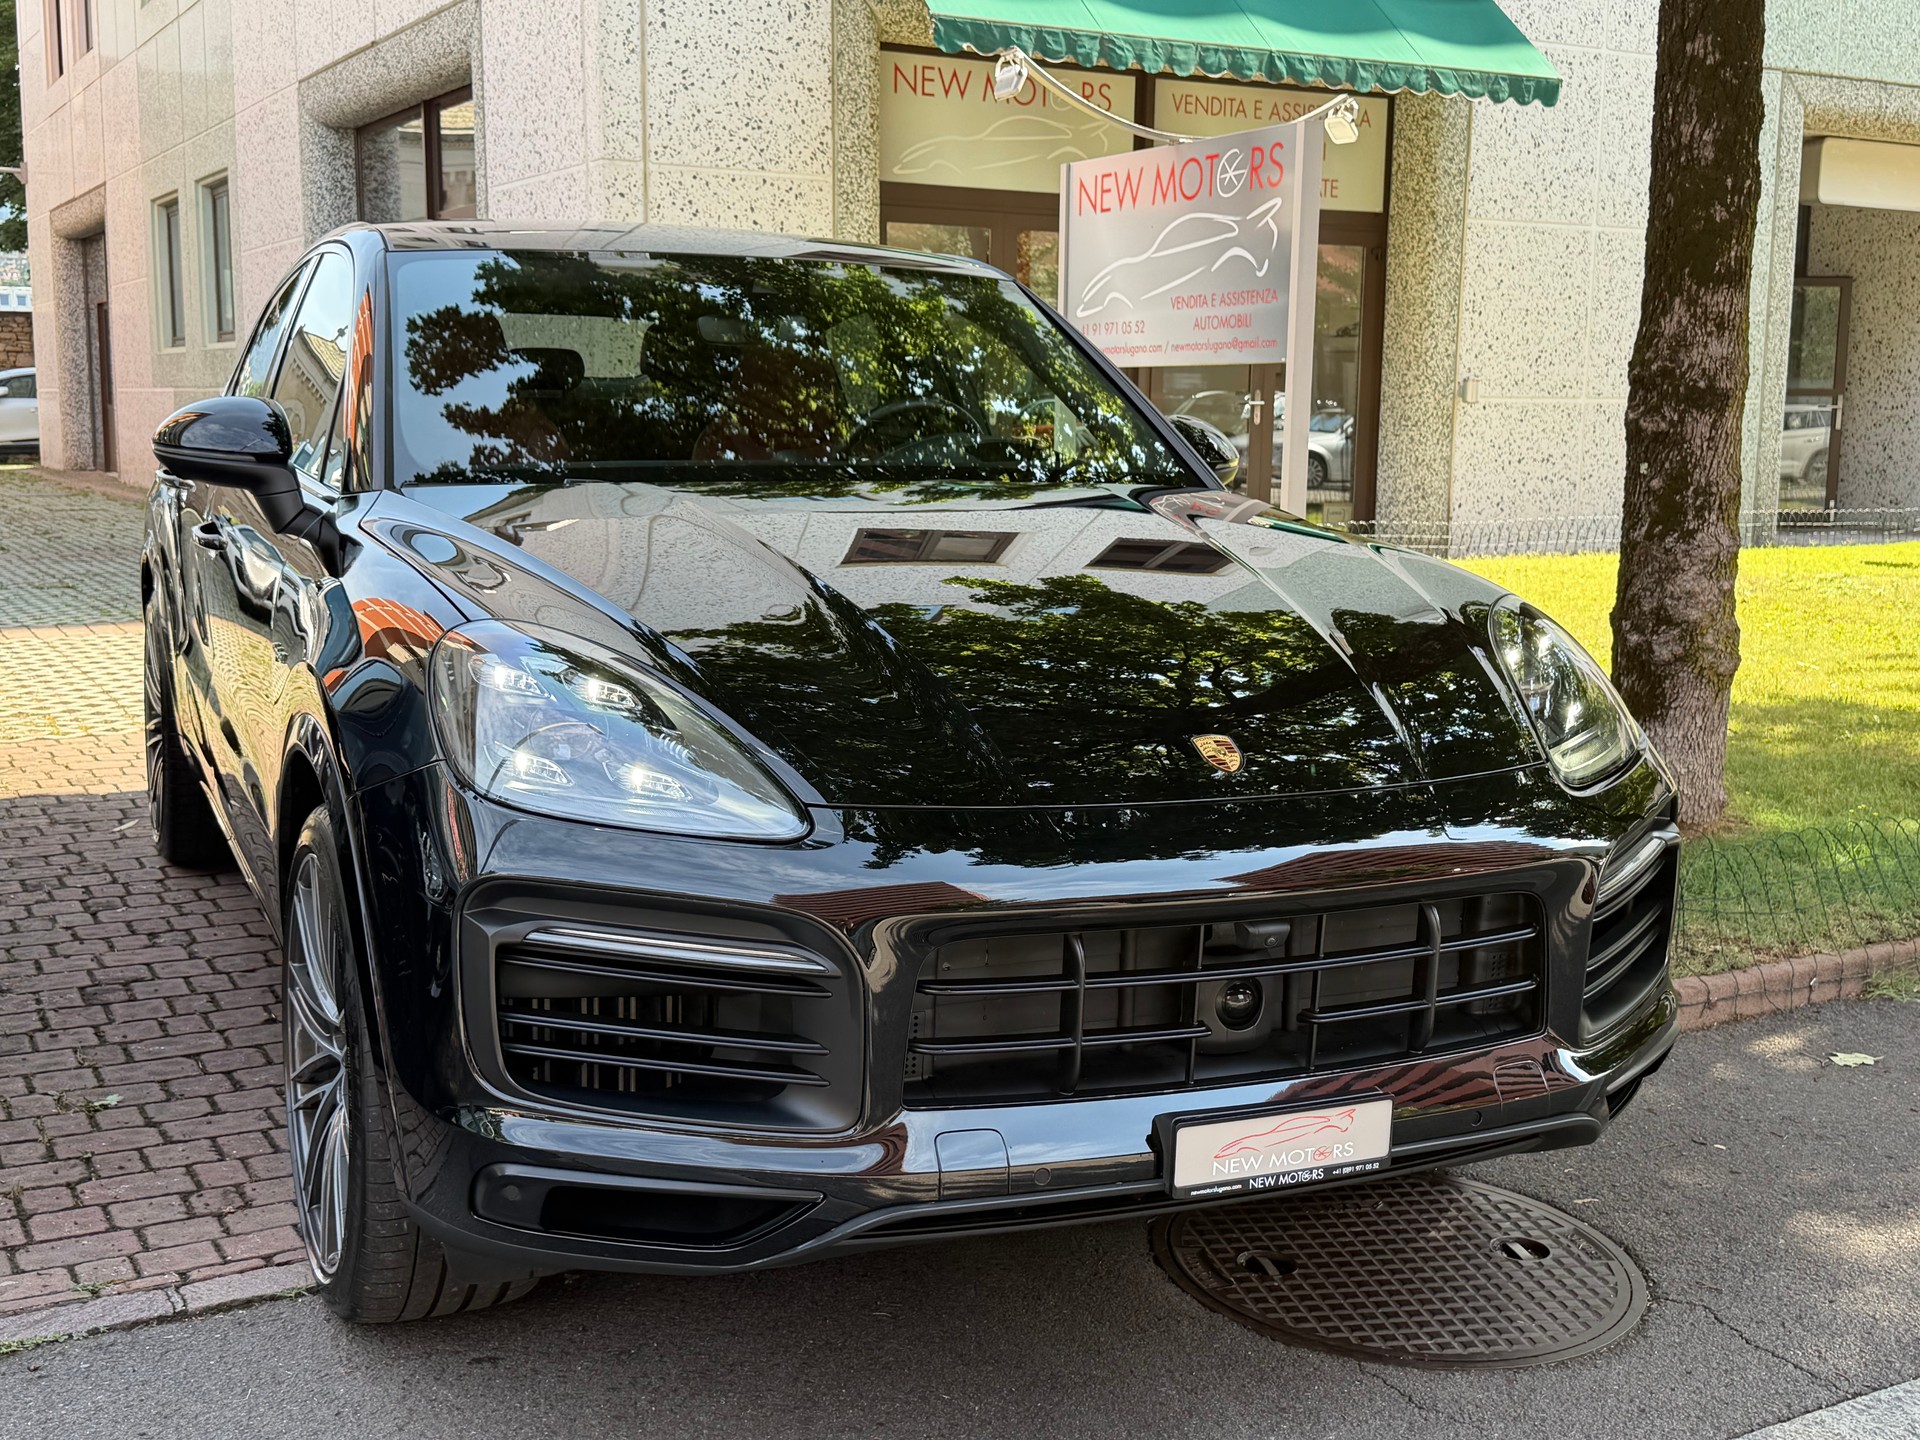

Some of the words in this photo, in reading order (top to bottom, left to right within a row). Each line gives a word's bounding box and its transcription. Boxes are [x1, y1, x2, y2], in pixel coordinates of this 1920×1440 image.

[894, 63, 972, 100] NEW
[1172, 93, 1248, 120] VENDITA
[1254, 100, 1263, 120] E
[1078, 166, 1144, 216] NEW
[1152, 142, 1284, 206] MOTORS
[1171, 293, 1209, 310] VENDITA
[1211, 292, 1217, 307] E
[1219, 288, 1279, 307] ASSISTENZA
[1092, 322, 1101, 336] 91
[1104, 321, 1119, 336] 971
[1122, 320, 1132, 334] 05
[1135, 320, 1145, 334] 52
[1193, 314, 1252, 331] AUTOMOBILI
[1171, 336, 1278, 354] newmotorslugano@gmail.com
[1212, 1154, 1263, 1176] NEW
[1269, 1142, 1354, 1169] MOTORS
[1249, 1175, 1276, 1190] NEW
[1278, 1168, 1324, 1186] MOTORS
